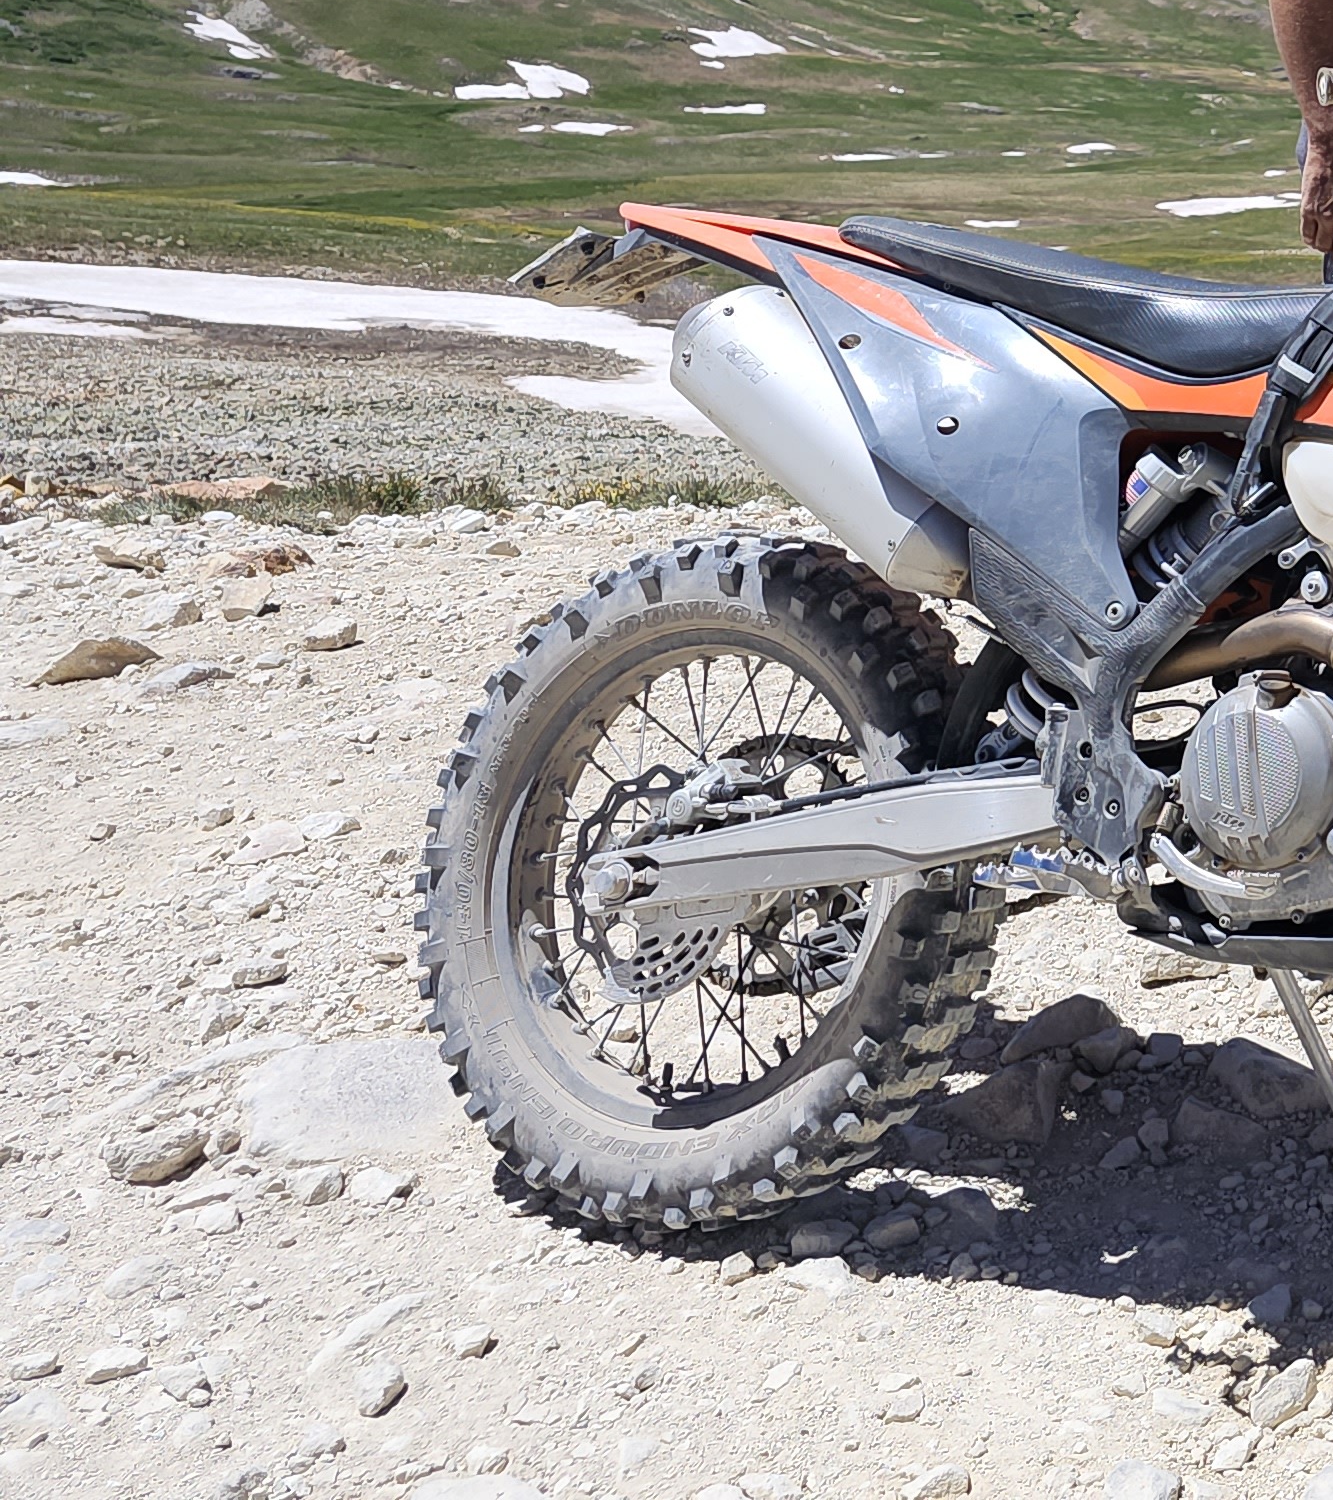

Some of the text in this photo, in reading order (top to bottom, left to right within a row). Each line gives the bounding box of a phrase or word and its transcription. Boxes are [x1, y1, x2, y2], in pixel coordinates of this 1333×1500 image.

[717, 341, 768, 384] KTM
[615, 601, 781, 642] DUNLOP
[1212, 811, 1245, 832] KTM
[556, 1117, 720, 1159] ENDURO
